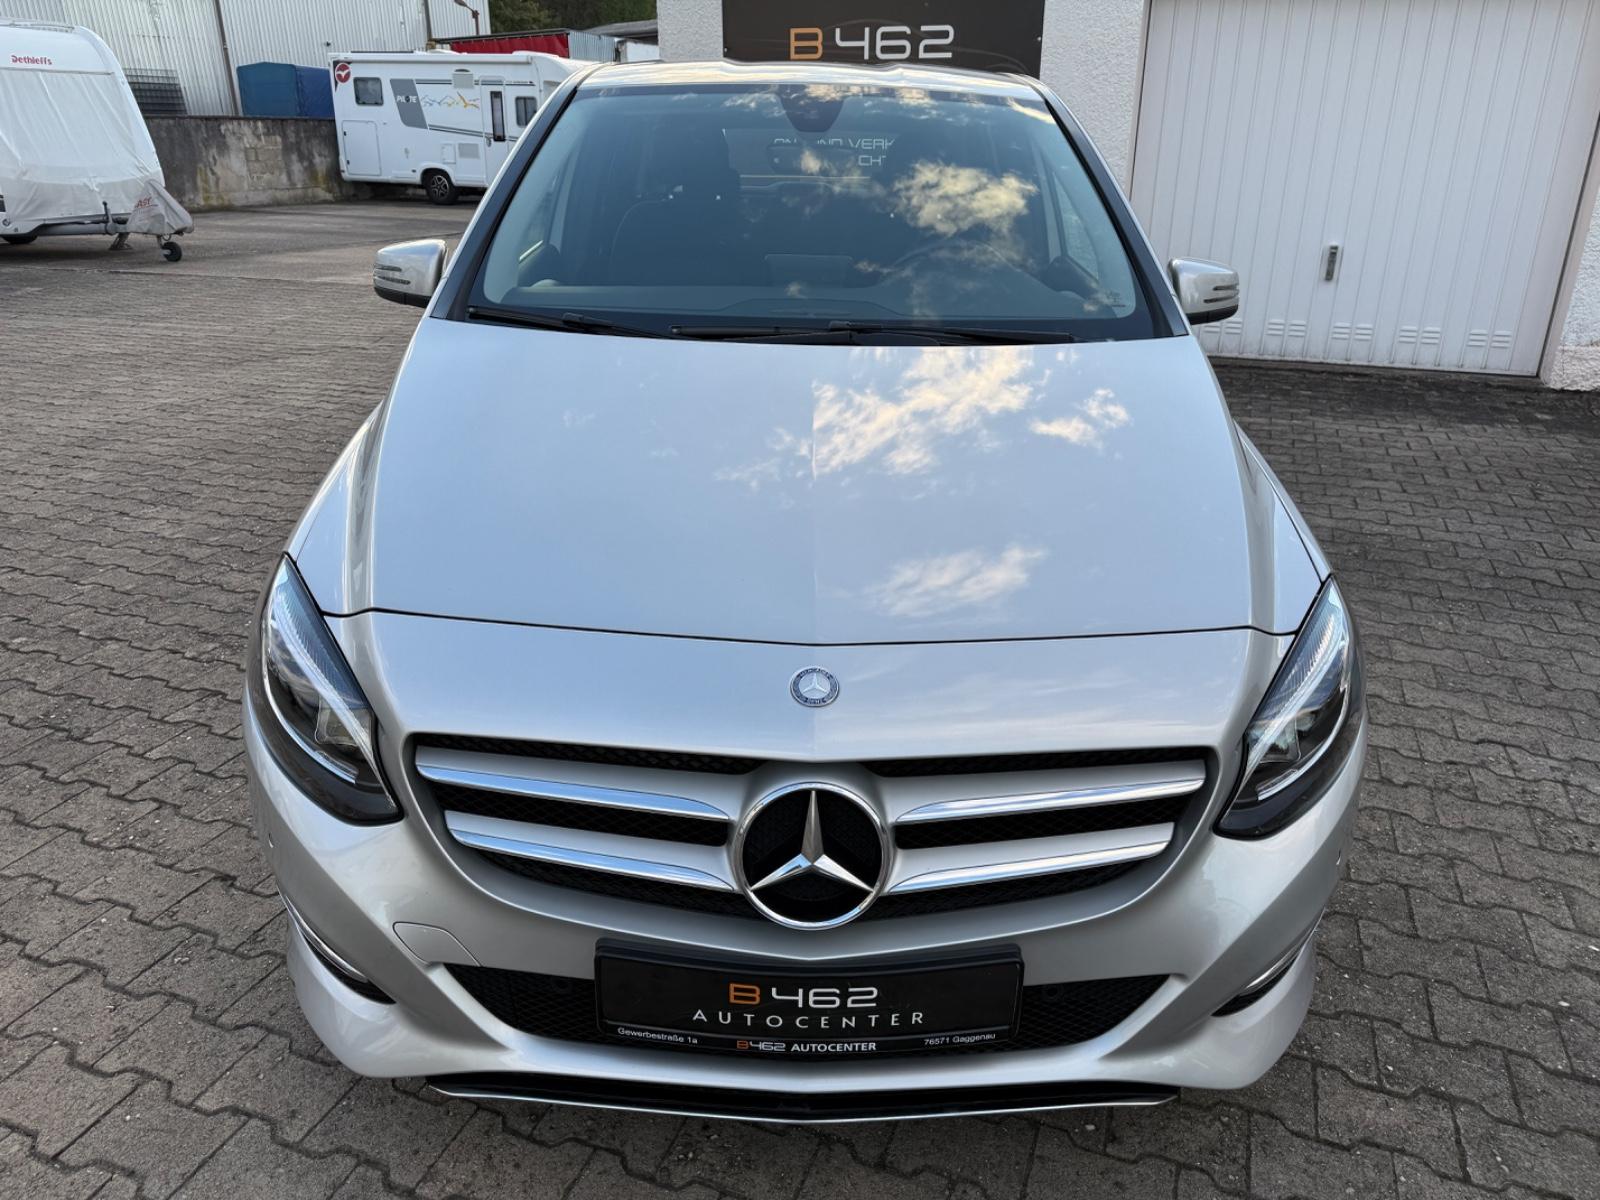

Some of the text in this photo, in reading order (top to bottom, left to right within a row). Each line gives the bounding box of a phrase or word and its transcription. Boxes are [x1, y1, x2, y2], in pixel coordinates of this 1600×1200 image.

[790, 24, 955, 60] B 462
[729, 983, 878, 1008] B 462
[692, 1009, 924, 1029] AUTOCENTER
[617, 1027, 685, 1043] Gewerbestraße
[924, 1033, 996, 1046] 76571 Gaggenau
[791, 1042, 877, 1052] AUTOCENTER
